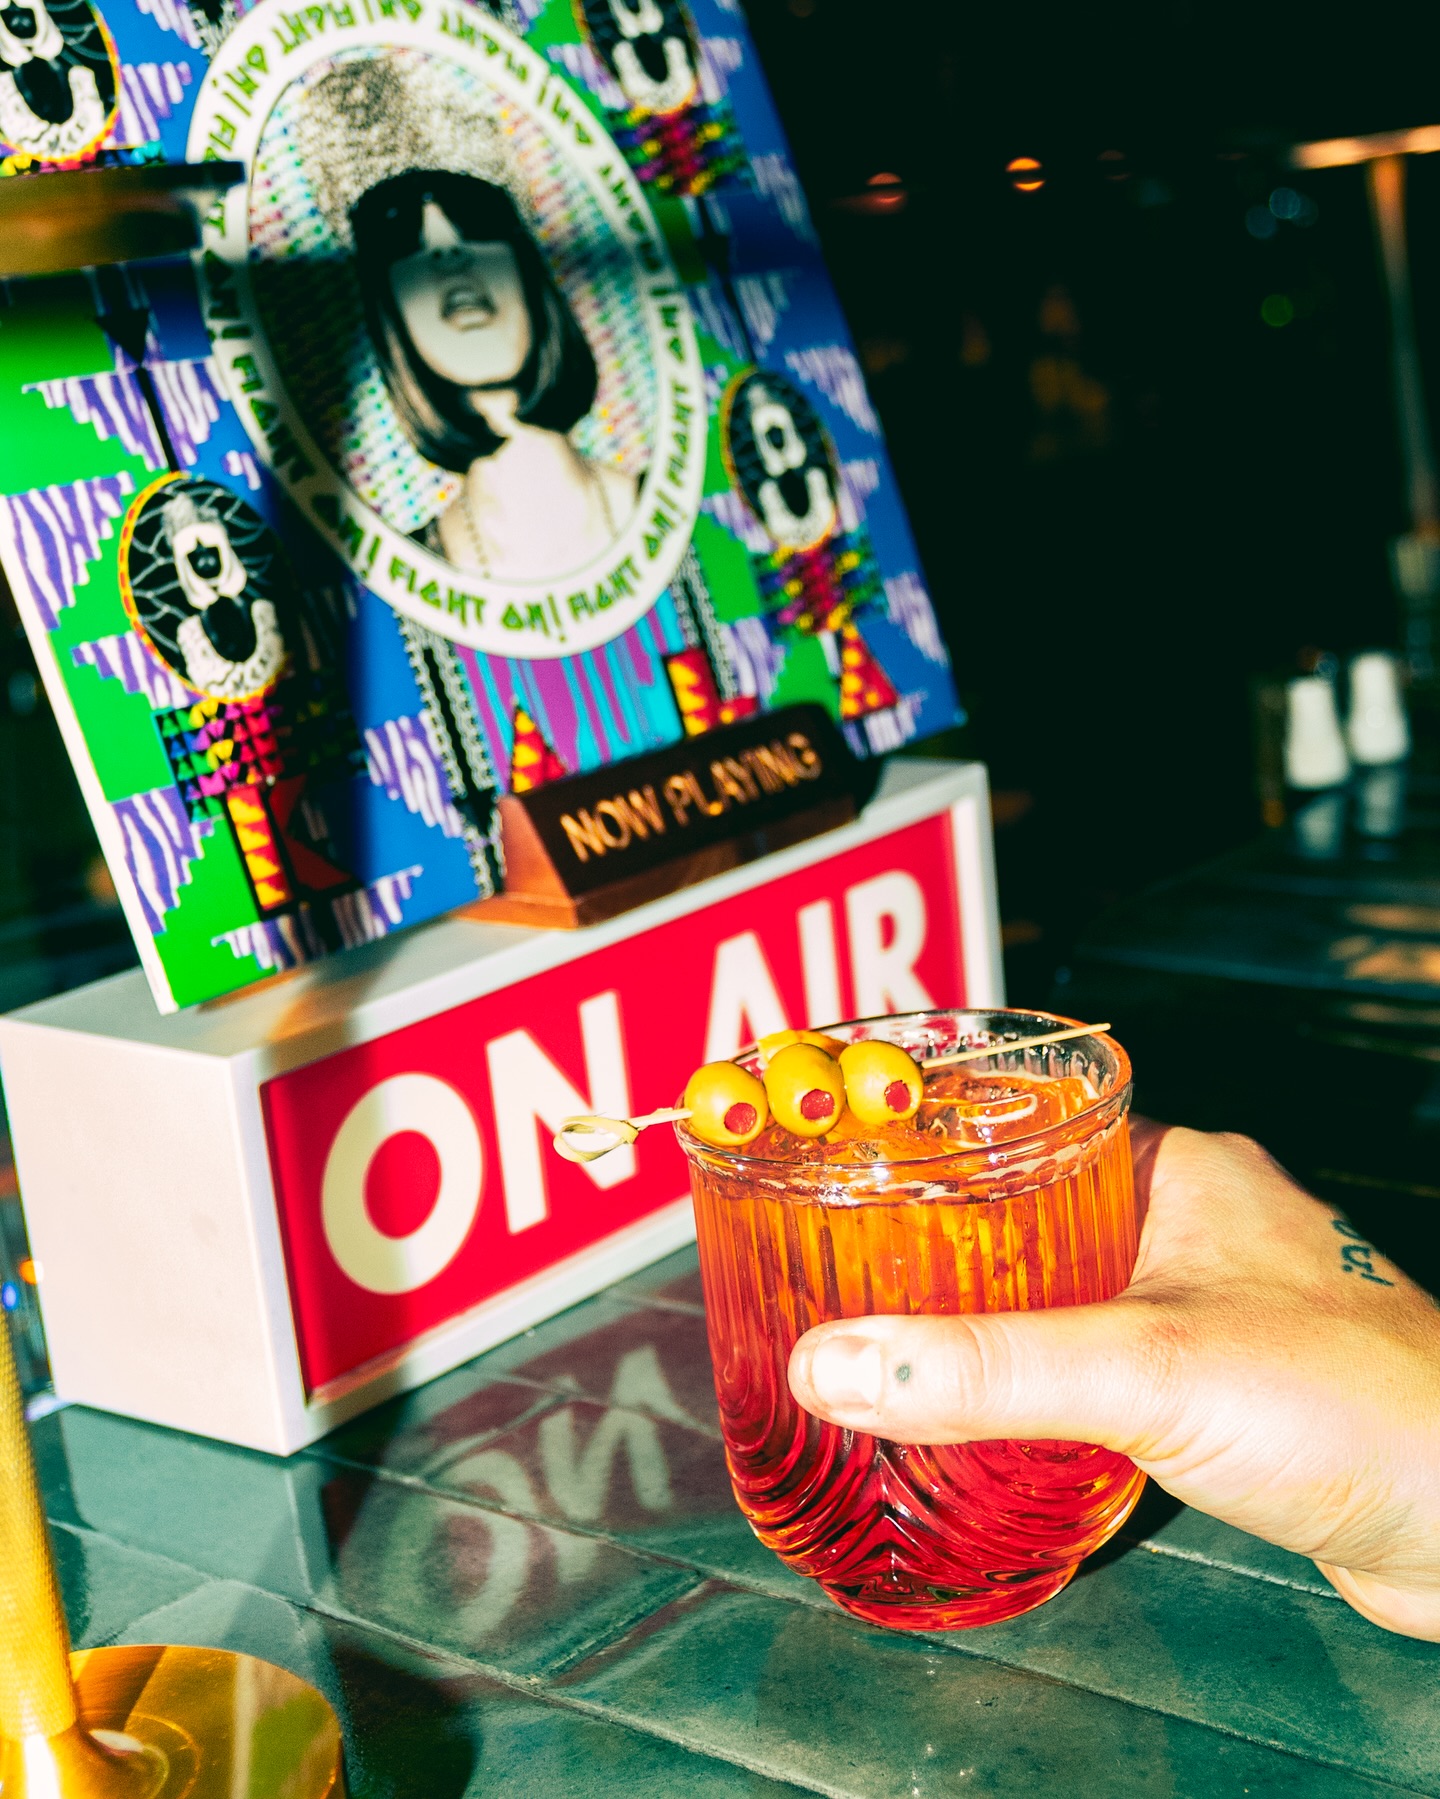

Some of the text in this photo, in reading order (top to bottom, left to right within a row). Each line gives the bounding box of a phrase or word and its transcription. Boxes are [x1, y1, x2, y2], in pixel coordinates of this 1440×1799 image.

[271, 2, 358, 55] FIGHT
[211, 43, 270, 118] ON!
[232, 354, 317, 484] FIGHT
[664, 380, 694, 488] FIGHT
[311, 493, 382, 579] ON!
[641, 488, 688, 562] ON!
[389, 555, 488, 628] FIGHT
[500, 591, 567, 643] ON!
[566, 552, 642, 623] FIGHT
[560, 732, 823, 863] NOW PLAYING
[320, 869, 938, 1295] ON AIR
